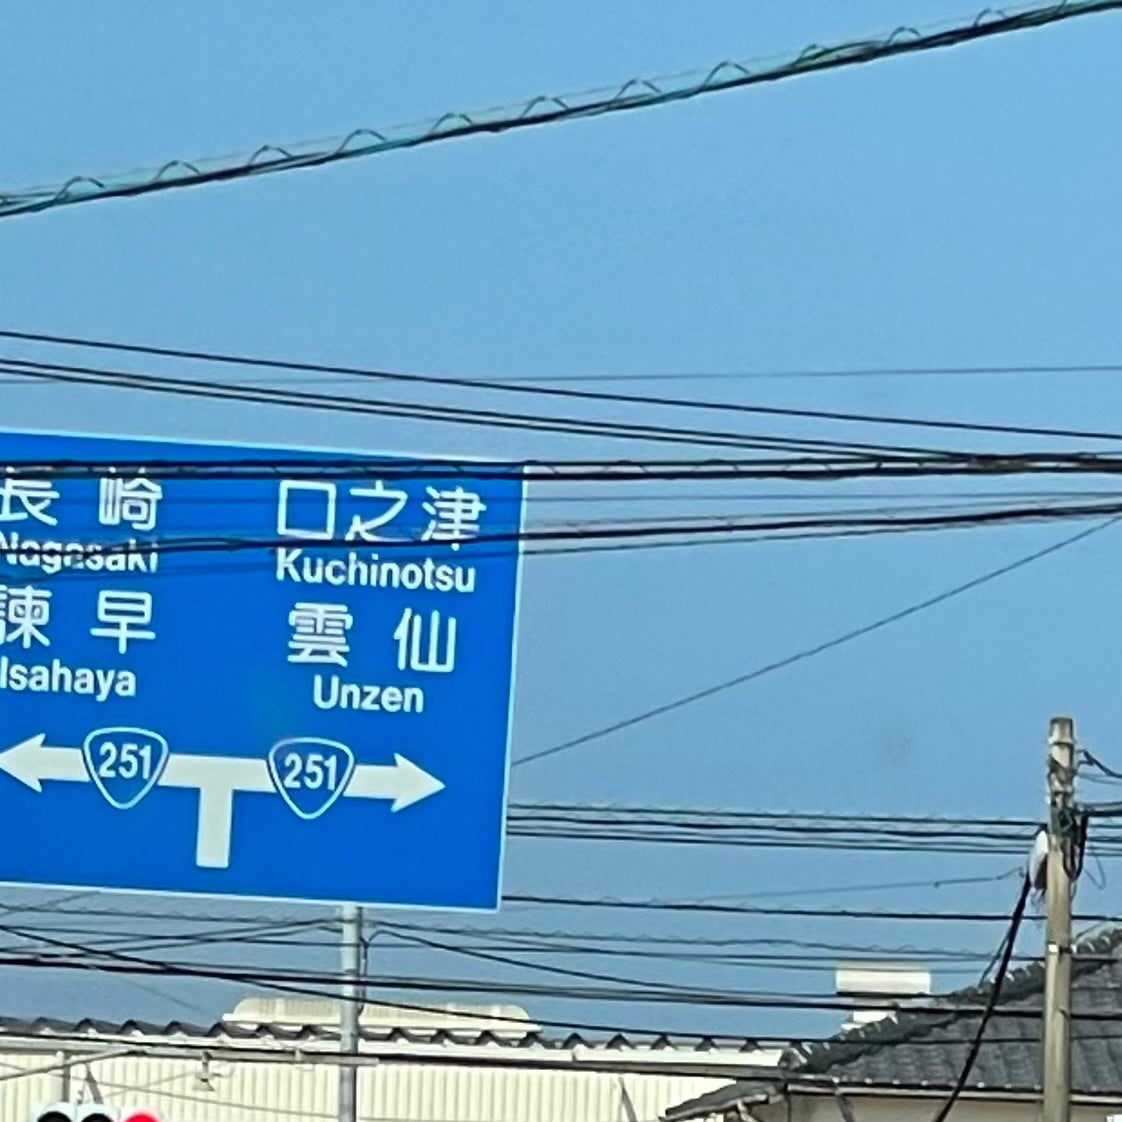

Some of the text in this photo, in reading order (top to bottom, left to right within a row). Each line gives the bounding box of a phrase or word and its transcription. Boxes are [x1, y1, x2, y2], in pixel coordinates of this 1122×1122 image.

[0, 466, 164, 532] 長崎
[276, 480, 488, 550] 口之津
[0, 530, 159, 574] Nagasaki
[275, 547, 477, 593] Kuchinotsu
[287, 601, 457, 674] 雲仙
[0, 658, 137, 702] Isahaya
[312, 674, 424, 713] Unzen
[98, 741, 152, 781] 251
[282, 753, 339, 791] 251
